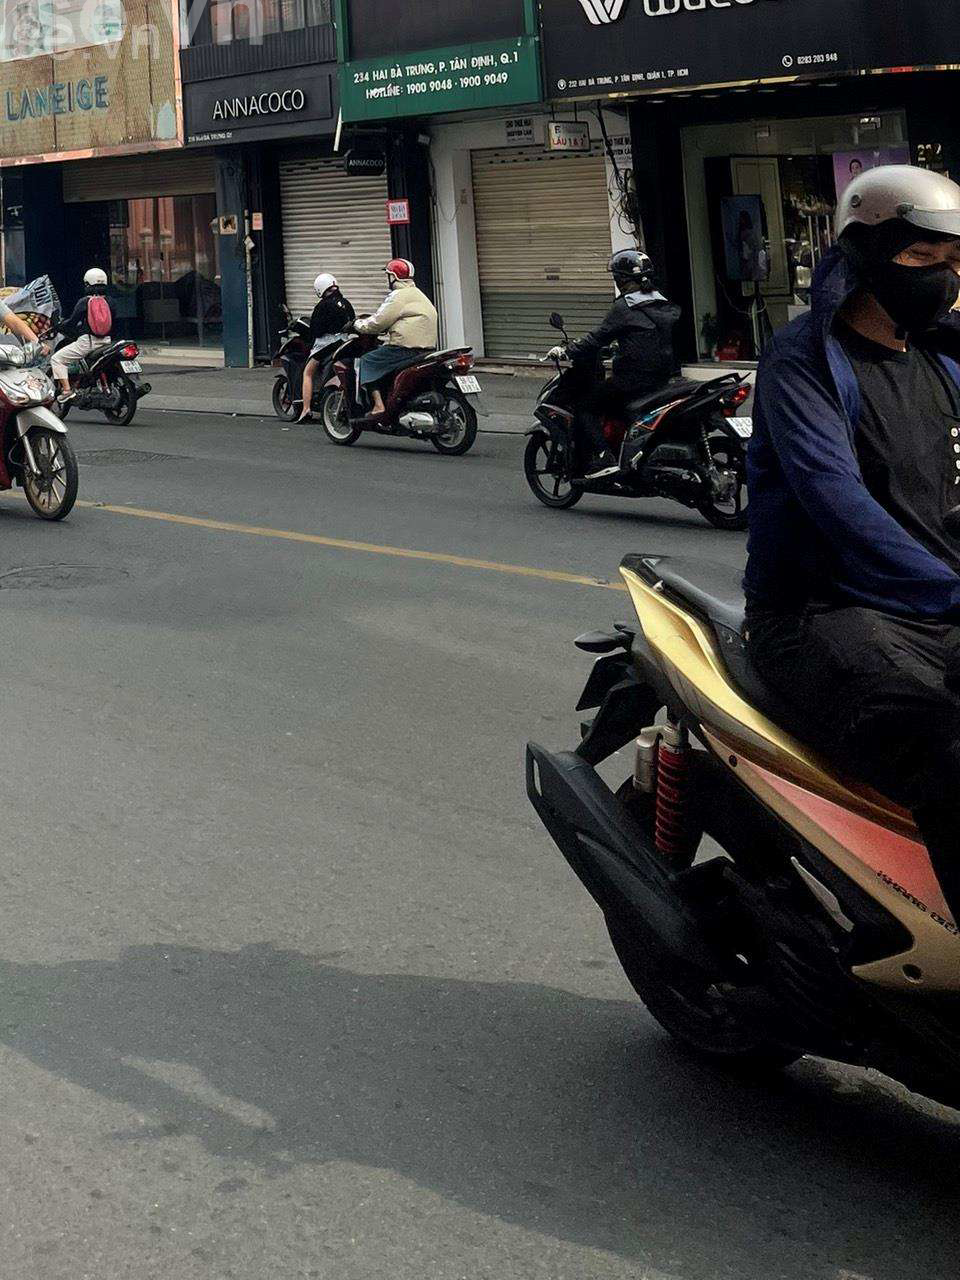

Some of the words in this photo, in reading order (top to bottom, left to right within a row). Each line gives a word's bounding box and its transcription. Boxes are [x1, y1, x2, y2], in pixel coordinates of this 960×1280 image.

[354, 72, 370, 84] 234
[372, 69, 388, 81] HAI
[391, 64, 404, 79] BÀ
[439, 60, 448, 72] P.
[449, 55, 467, 71] TÂN
[471, 55, 499, 71] ĐỊNH,
[406, 82, 428, 95] 1900
[429, 78, 453, 93] 9048
[460, 76, 481, 89] 1900
[484, 72, 508, 85] 9049
[5, 75, 110, 122] LANEIGE
[212, 89, 305, 120] ANNACOCO
[349, 159, 384, 168] ANNACOCO
